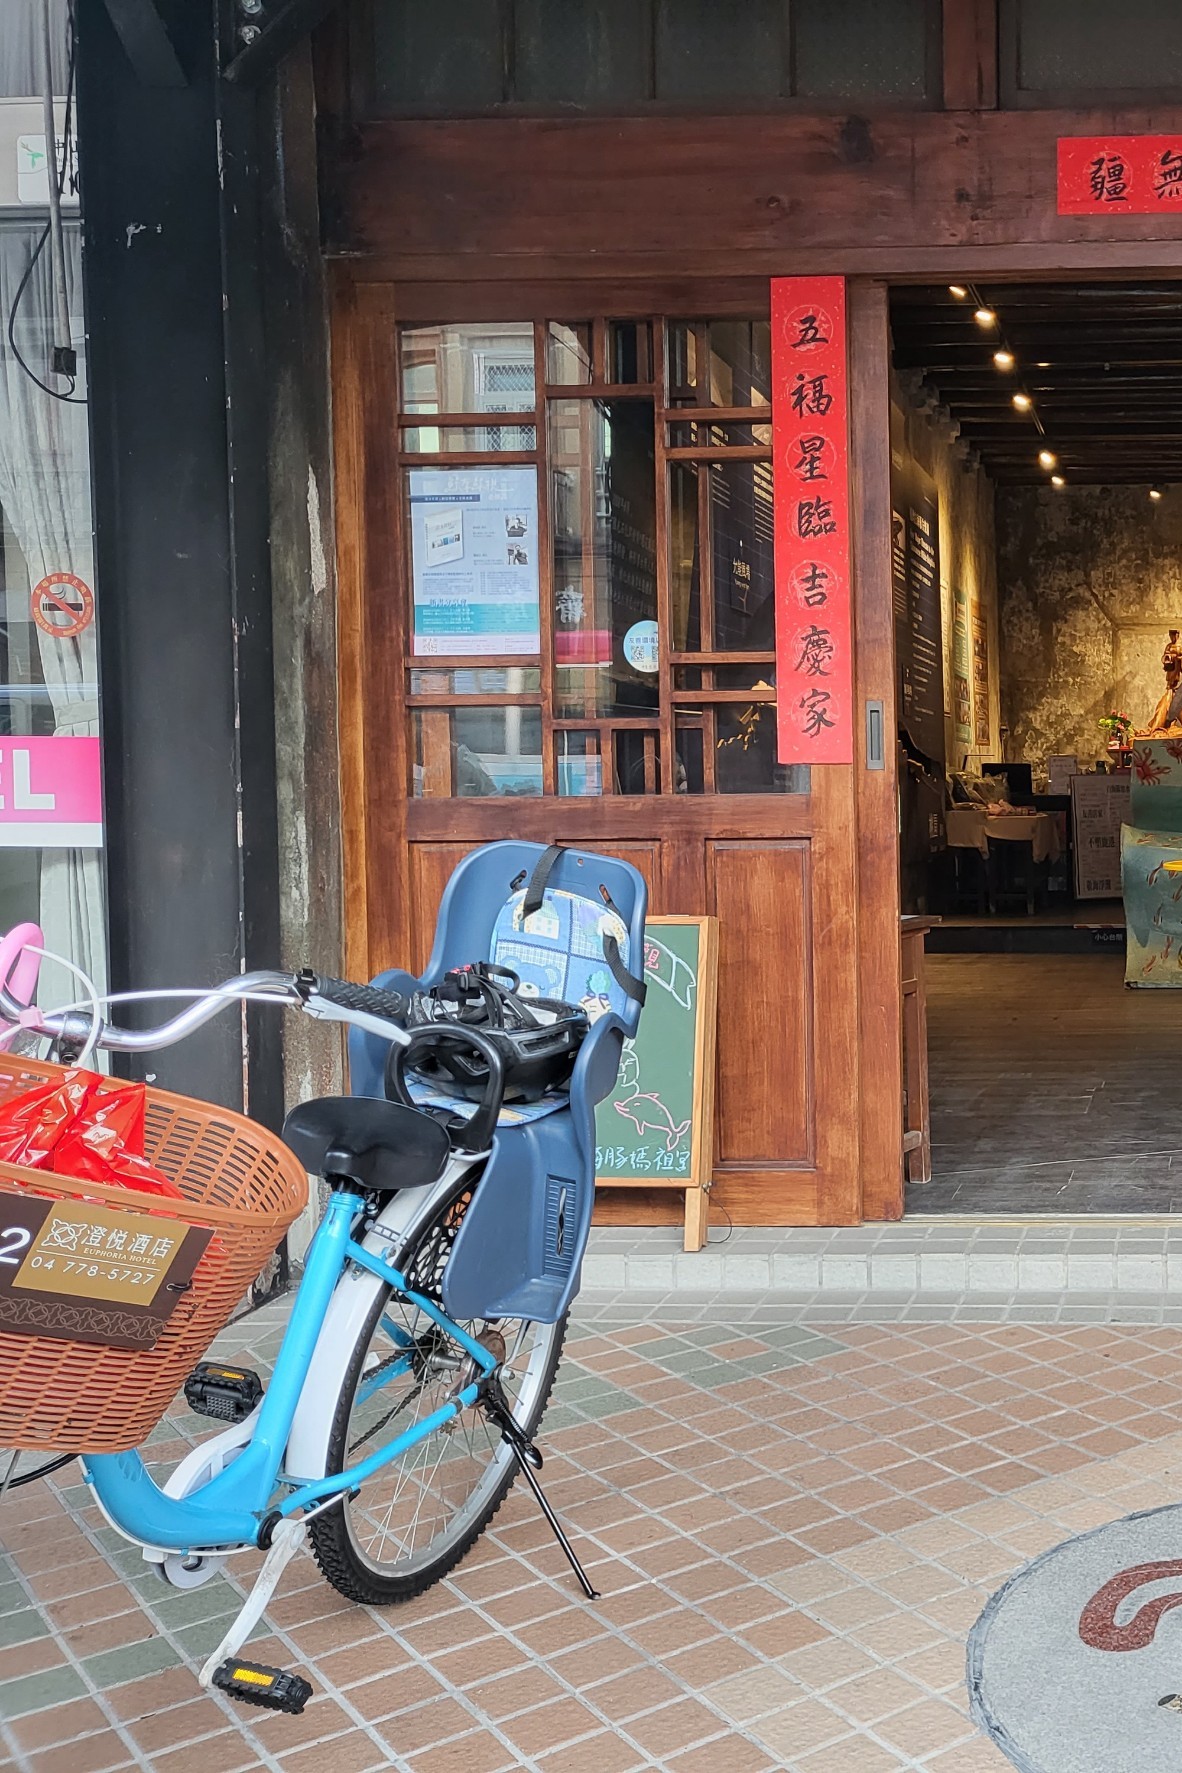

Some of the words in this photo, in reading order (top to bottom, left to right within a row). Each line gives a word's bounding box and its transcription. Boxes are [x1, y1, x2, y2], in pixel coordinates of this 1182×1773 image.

[789, 315, 837, 739] 五福星臨吉慶家
[80, 1224, 175, 1259] 澄悅酒店
[83, 1247, 128, 1261] EUPHORIA
[129, 1255, 157, 1265] HOTEL
[31, 1256, 56, 1271] 04
[62, 1261, 156, 1286] 778-5727
